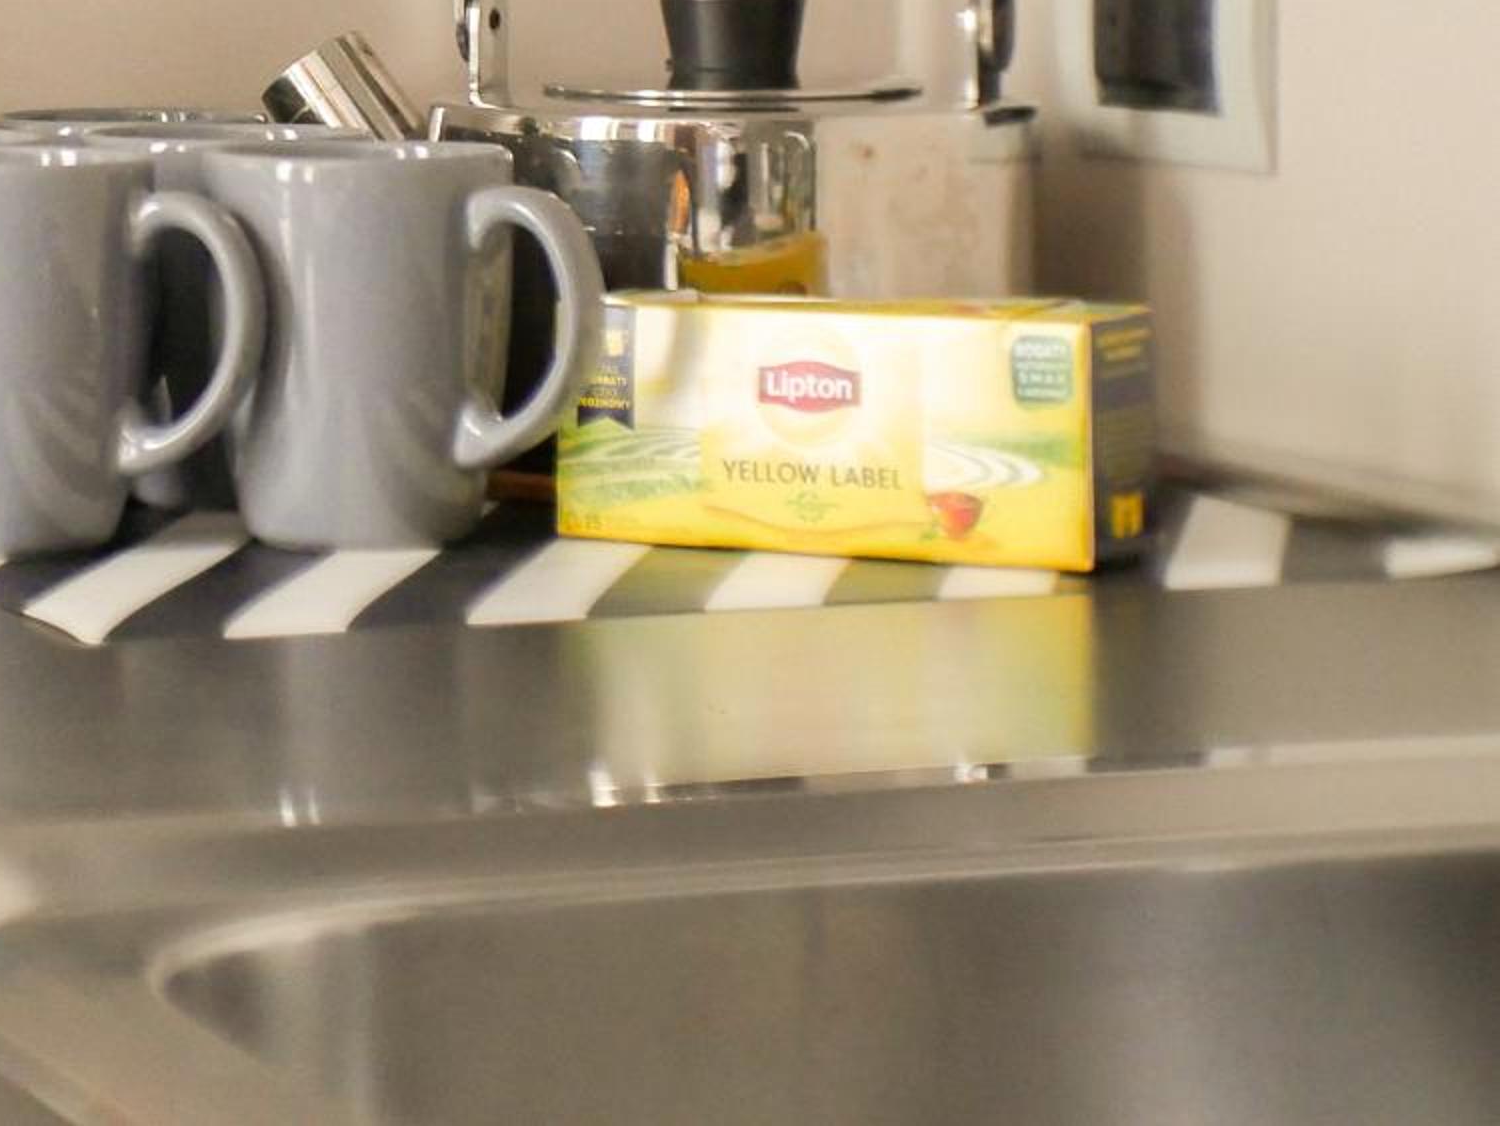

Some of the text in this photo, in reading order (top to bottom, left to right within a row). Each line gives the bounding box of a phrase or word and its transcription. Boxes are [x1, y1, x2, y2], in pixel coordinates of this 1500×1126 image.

[765, 369, 853, 404] Lipton
[723, 460, 903, 491] YELLOW LABEL
